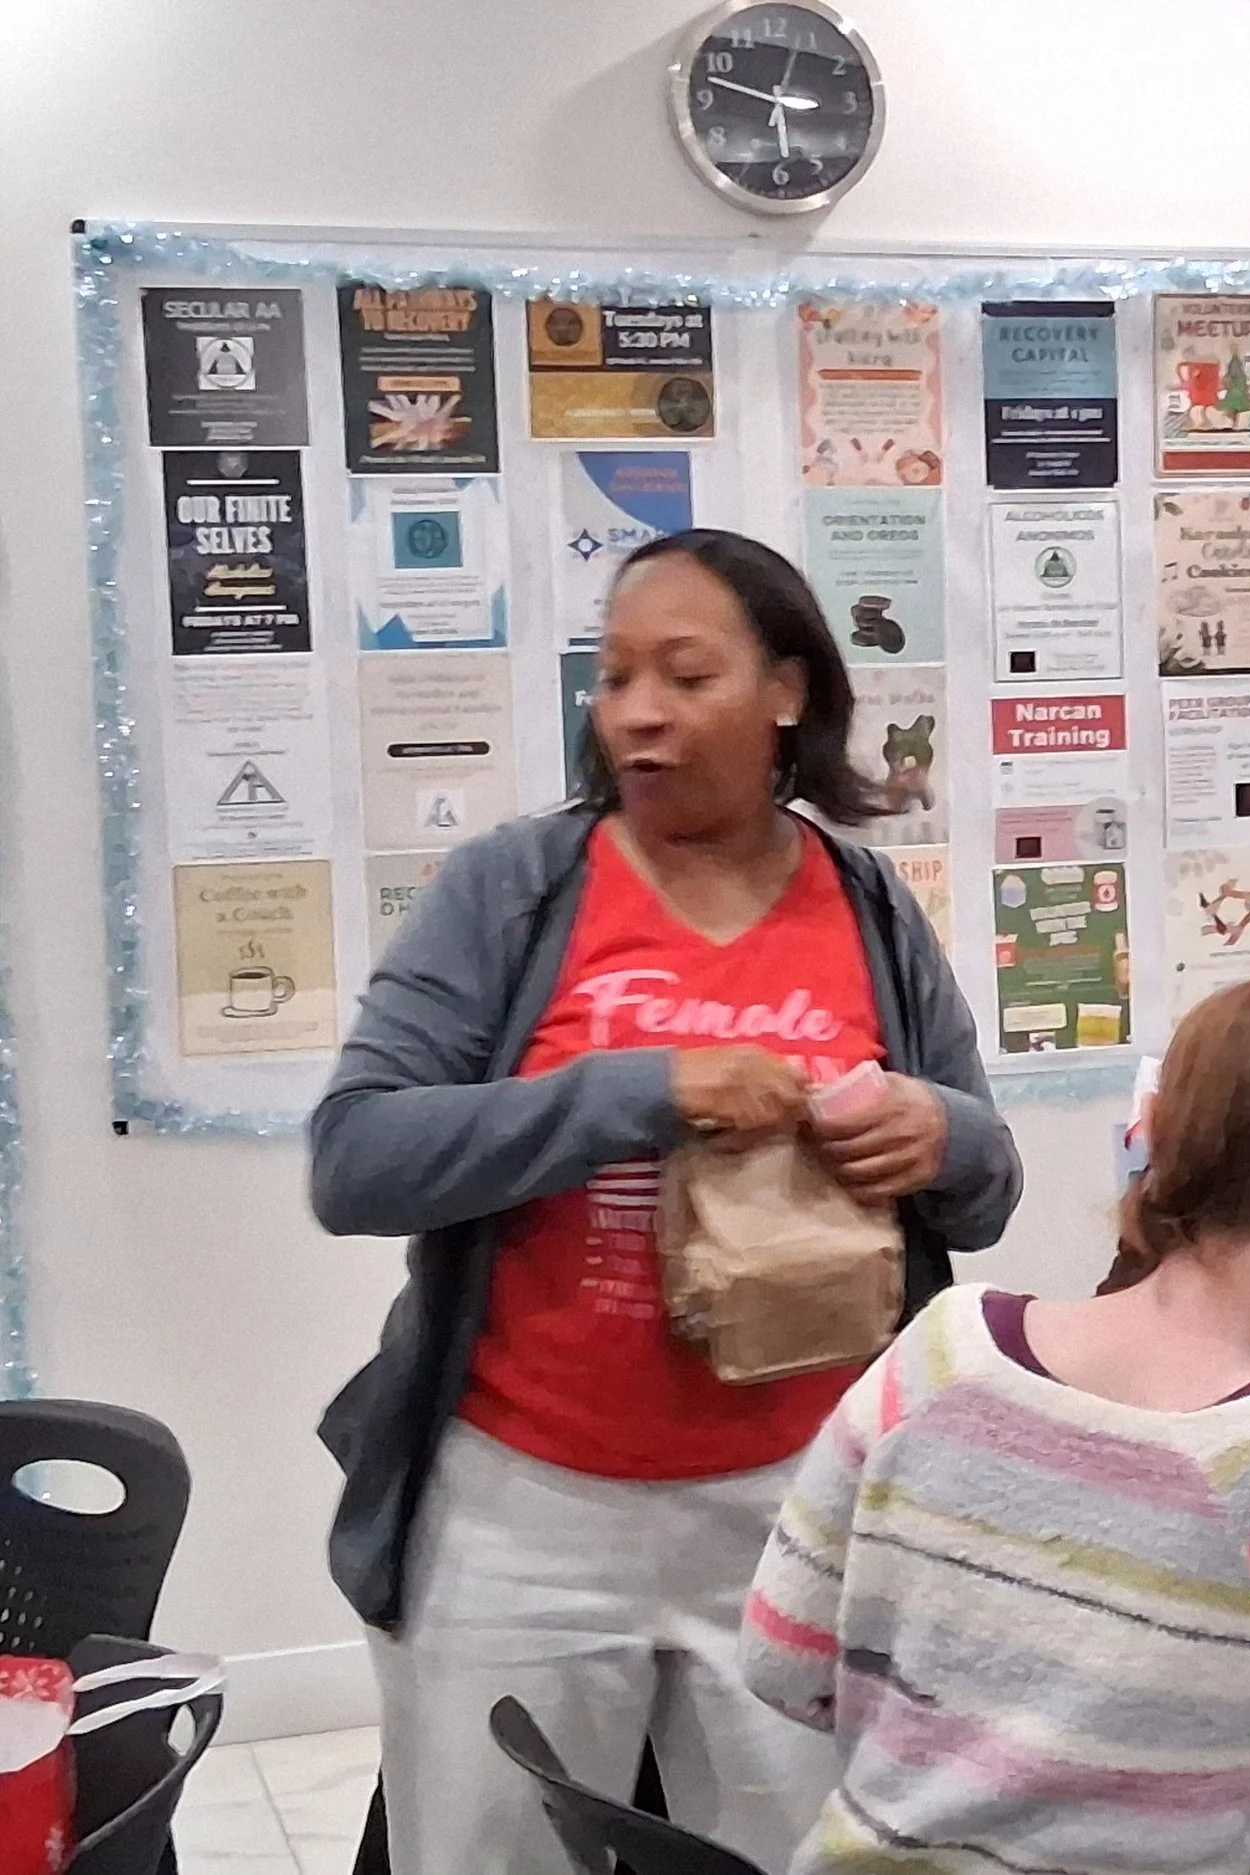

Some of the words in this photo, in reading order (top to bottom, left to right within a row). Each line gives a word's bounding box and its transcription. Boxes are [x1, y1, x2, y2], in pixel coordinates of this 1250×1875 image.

[764, 17, 787, 37] 12
[731, 29, 755, 48] 11
[809, 32, 817, 50] 1
[706, 52, 733, 73] 10
[832, 55, 848, 75] 2
[696, 89, 713, 110] 9
[842, 91, 858, 114] 3
[708, 126, 727, 148] 8
[772, 161, 790, 185] 6
[163, 301, 250, 319] SECULAR
[255, 302, 282, 319] AA
[602, 310, 683, 331] Tuesdays
[685, 314, 704, 328] at
[660, 332, 691, 348] PM
[1000, 326, 1099, 341] RECOVERY
[1011, 347, 1089, 363] CAPITAL
[177, 496, 222, 524] OUR
[225, 495, 293, 524] FINITE
[822, 515, 927, 526] ORIENTATION
[195, 526, 273, 555] SELVES
[831, 530, 864, 541] AND
[1015, 703, 1102, 722] Narcan
[1007, 725, 1111, 748] Training
